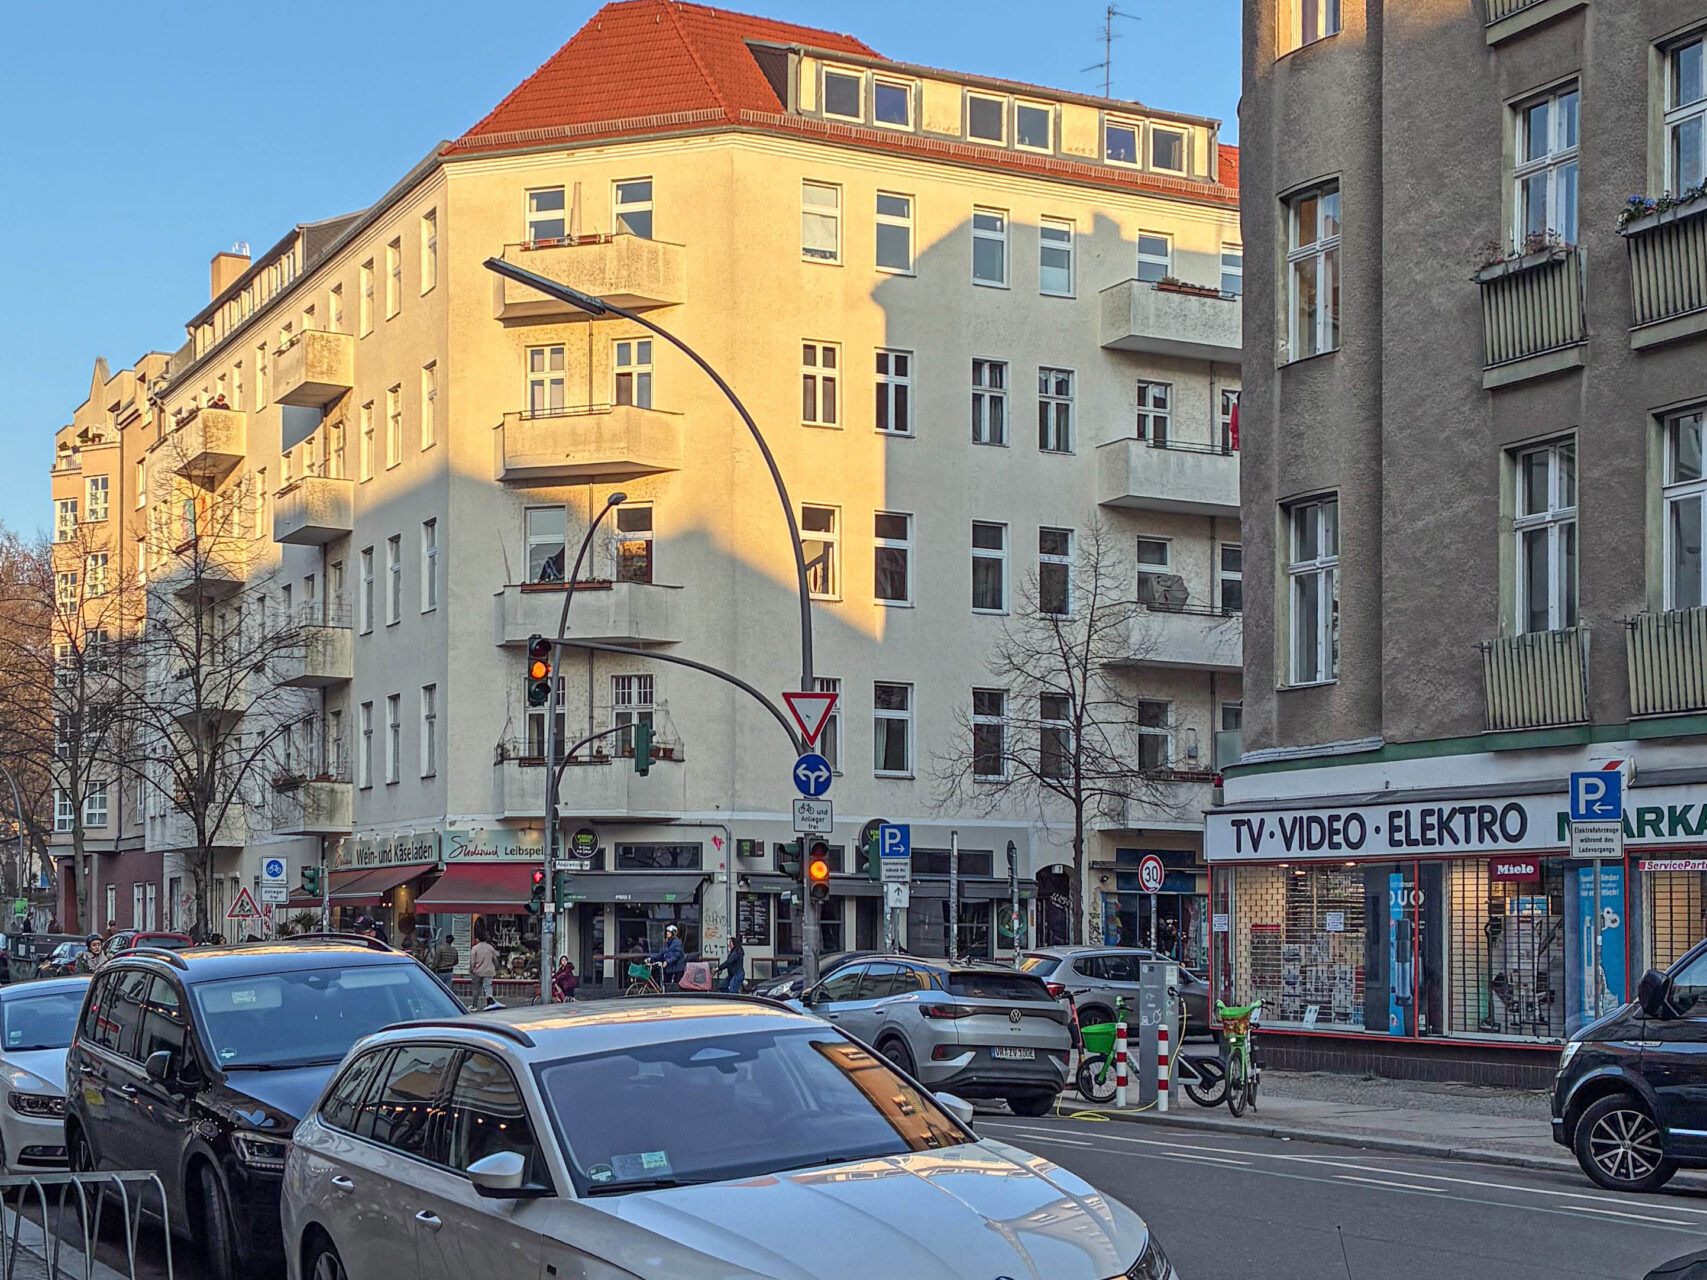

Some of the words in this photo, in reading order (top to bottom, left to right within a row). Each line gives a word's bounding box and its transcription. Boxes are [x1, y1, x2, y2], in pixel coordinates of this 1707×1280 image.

[1578, 777, 1607, 815] P
[800, 816, 825, 824] Anlieger
[1231, 818, 1265, 853] TV
[1279, 812, 1367, 852] VIDEO
[1388, 802, 1528, 848] ELEKTRO
[1574, 826, 1619, 834] Elektrofahrzeuge
[884, 828, 901, 853] P
[356, 846, 377, 866] Wein-
[378, 844, 392, 864] und
[393, 840, 433, 862] Käseladen
[1578, 846, 1615, 854] Ladevorgangs
[1144, 866, 1158, 882] 30
[1497, 863, 1534, 875] Miele
